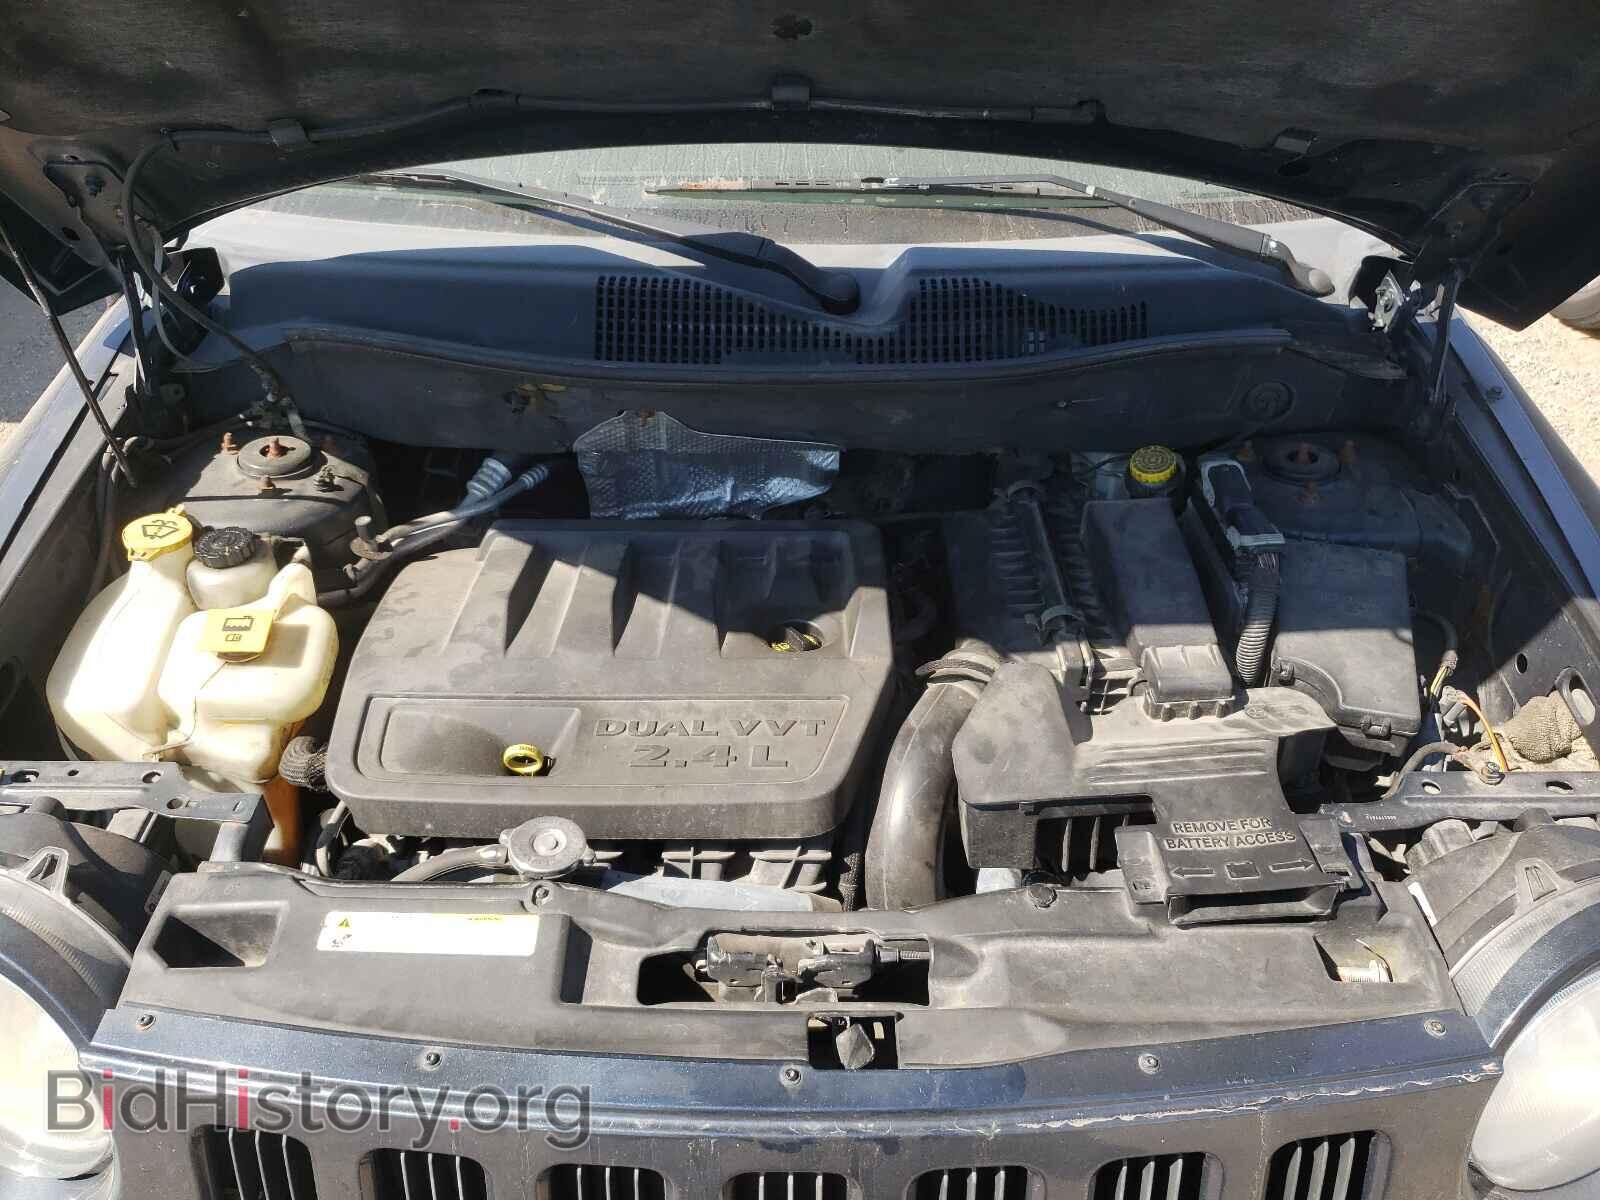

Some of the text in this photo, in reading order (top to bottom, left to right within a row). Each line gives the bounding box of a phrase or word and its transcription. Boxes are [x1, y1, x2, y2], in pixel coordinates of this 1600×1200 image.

[595, 719, 826, 737] DUAL VVT
[1172, 816, 1273, 834] REMOVE FOR
[1164, 831, 1296, 849] BATTERY ACCESS
